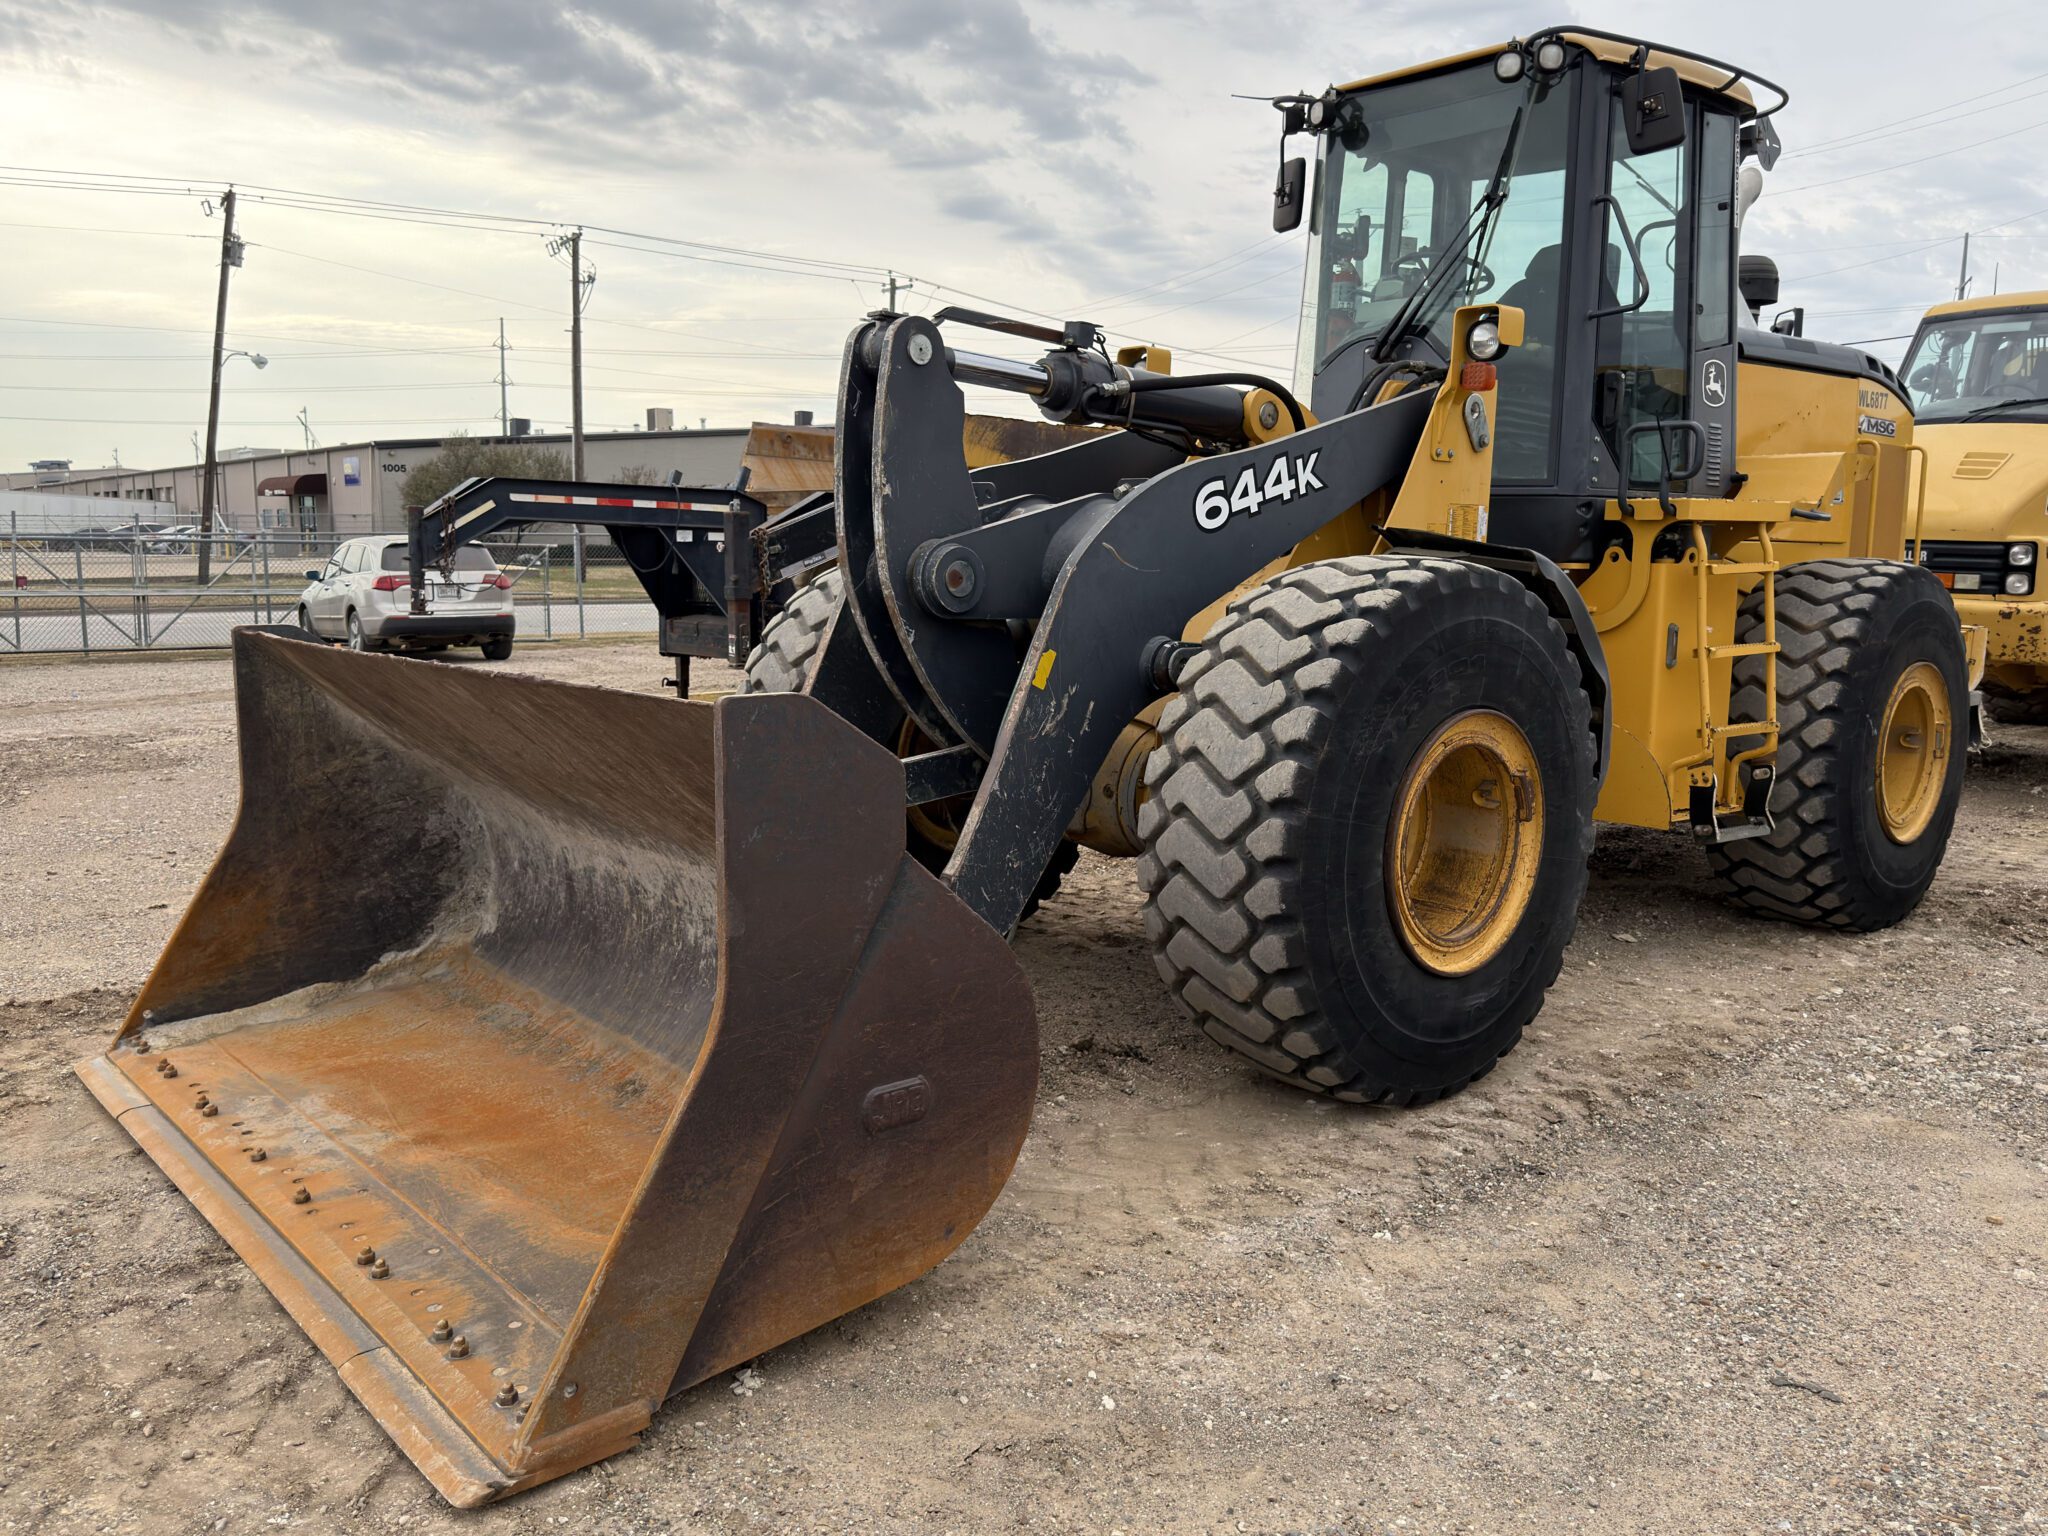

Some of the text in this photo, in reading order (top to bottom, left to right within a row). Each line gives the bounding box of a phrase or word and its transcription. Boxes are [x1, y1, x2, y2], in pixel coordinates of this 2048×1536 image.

[1858, 390, 1888, 409] WL6877
[1867, 419, 1895, 435] MSG
[382, 464, 407, 473] 1005
[1194, 450, 1325, 531] 644K
